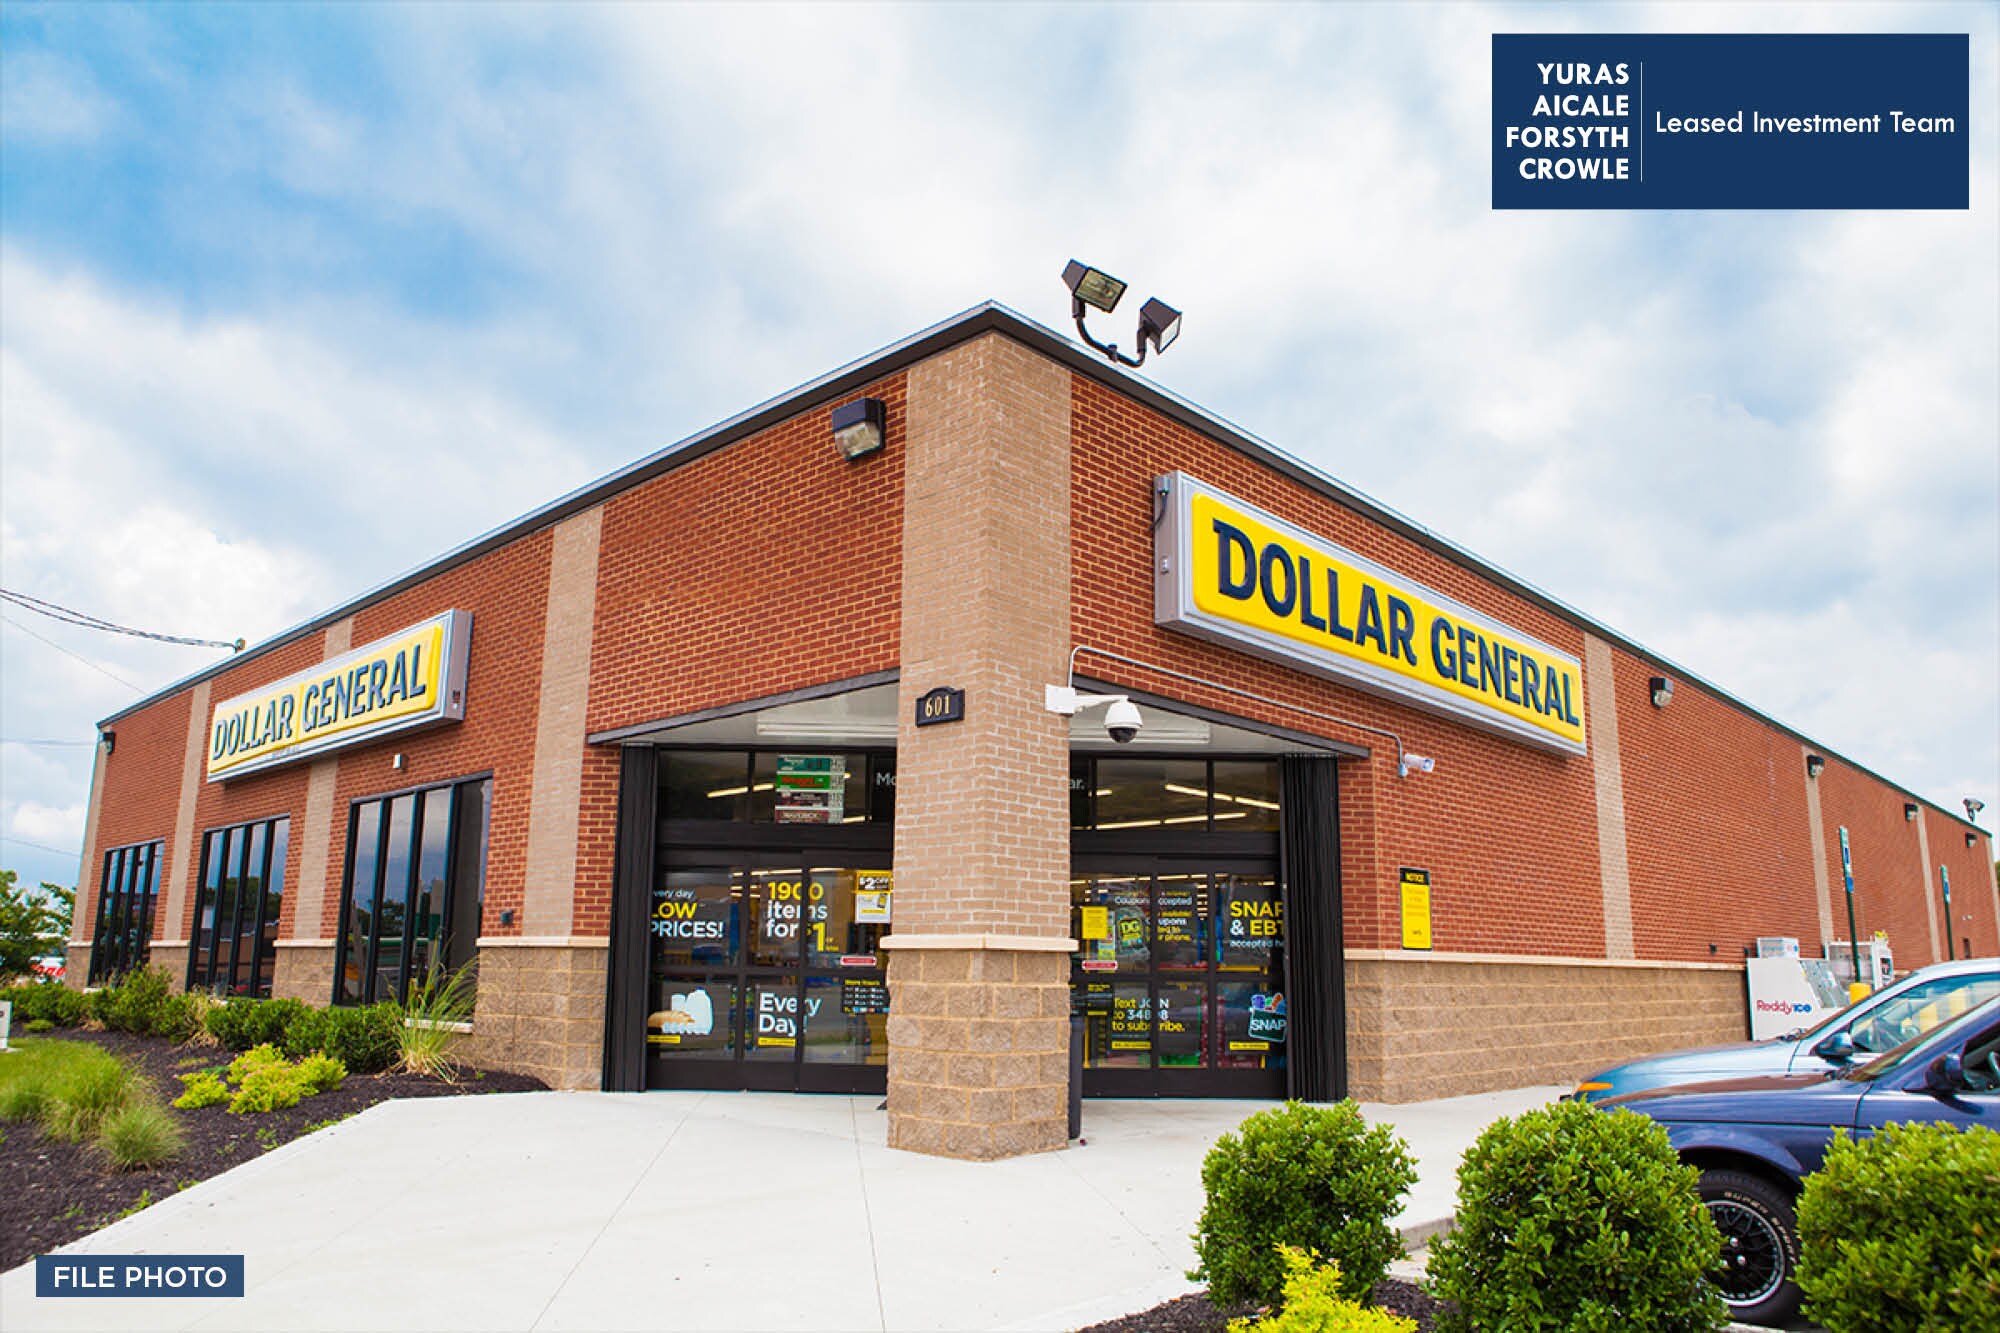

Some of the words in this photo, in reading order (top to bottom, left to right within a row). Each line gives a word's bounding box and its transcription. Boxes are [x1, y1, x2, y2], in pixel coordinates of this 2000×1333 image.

[1212, 517, 1418, 667] DOLLAR
[1430, 616, 1580, 728] GENERAL
[212, 692, 295, 761] DOLLAR
[301, 644, 427, 733] GENERAL
[924, 695, 951, 718] 601
[766, 918, 800, 938] for
[1229, 919, 1245, 936] &
[1114, 998, 1136, 1009] Text
[1111, 1020, 1125, 1031] to
